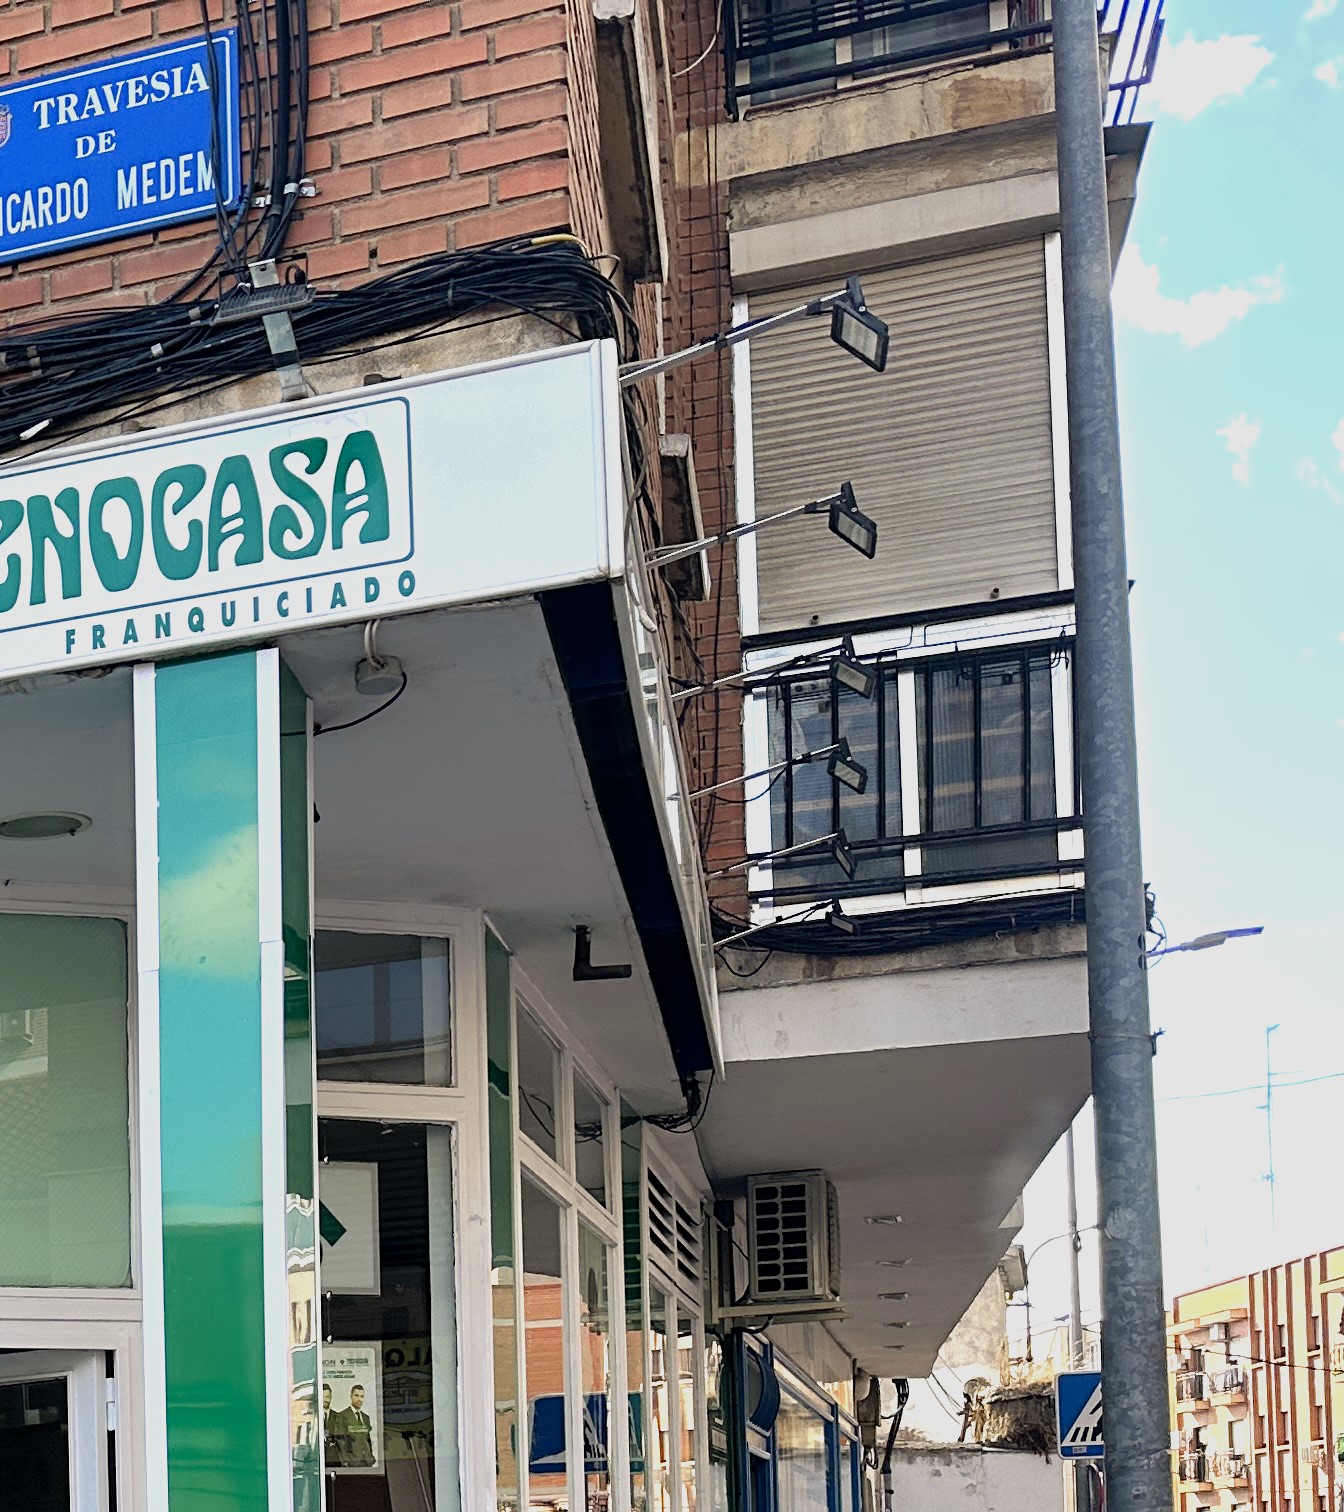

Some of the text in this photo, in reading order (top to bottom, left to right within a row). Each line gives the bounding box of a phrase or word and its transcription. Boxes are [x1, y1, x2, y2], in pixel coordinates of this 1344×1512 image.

[33, 62, 210, 130] TRAVESIA
[75, 129, 116, 159] DE
[117, 150, 216, 211] MEDEM
[64, 570, 418, 654] FRANQUICIADO
